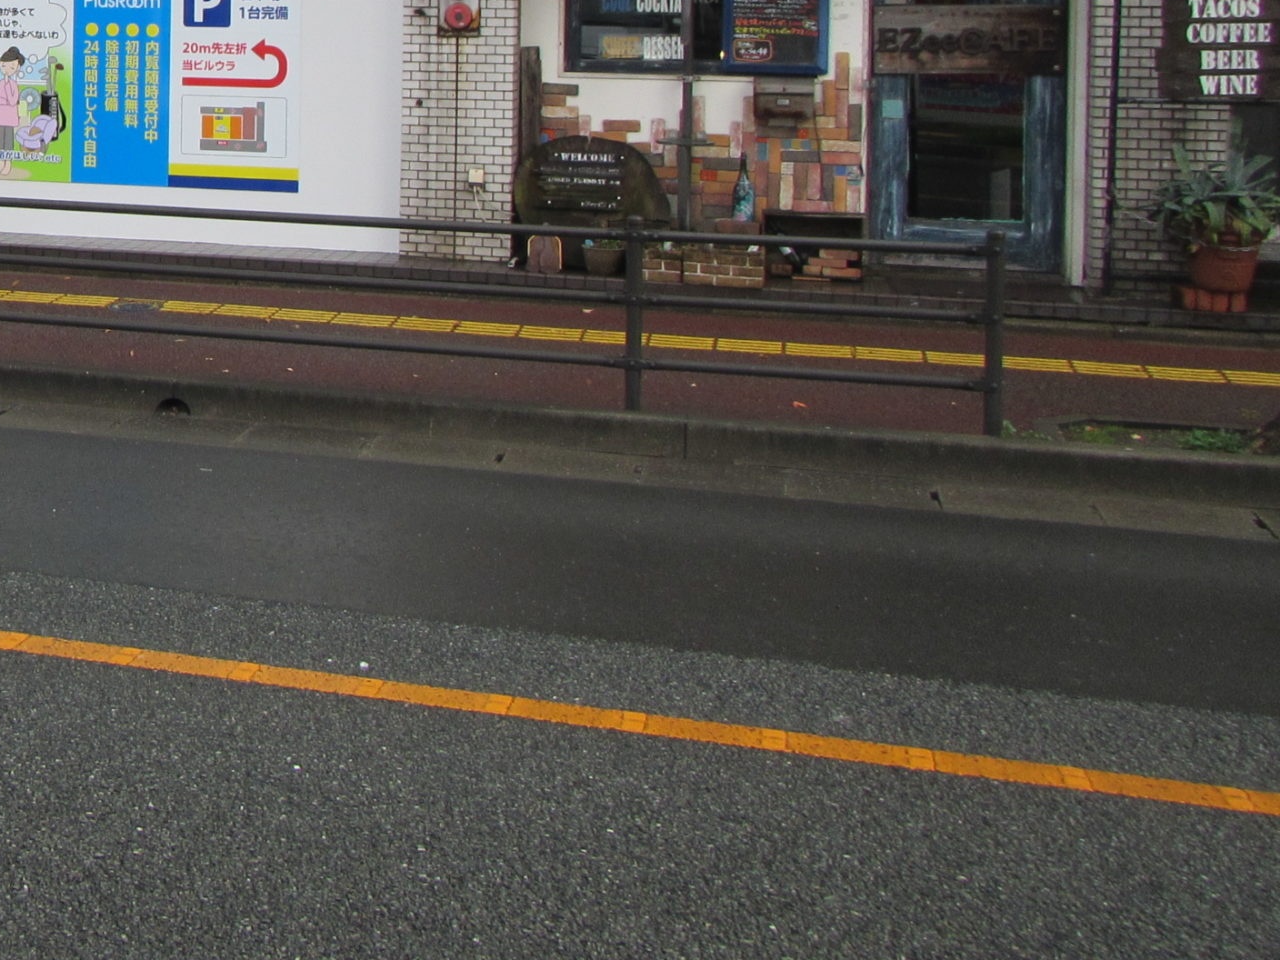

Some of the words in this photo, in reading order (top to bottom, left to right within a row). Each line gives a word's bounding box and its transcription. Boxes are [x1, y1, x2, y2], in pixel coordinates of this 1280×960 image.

[239, 6, 288, 20] 1台完備
[1186, 23, 1271, 43] COFFEE
[182, 42, 247, 55] 20m先左折
[182, 59, 236, 71] 当ビルウラ
[1201, 49, 1260, 70] BEER
[104, 40, 119, 112] 除湿器完備
[124, 40, 139, 128] 初期費用無料
[1199, 75, 1258, 95] WINE
[145, 41, 160, 143] 内覧随時受付中
[83, 40, 99, 168] 24時間出し入れ自由
[560, 152, 616, 162] WELCOME
